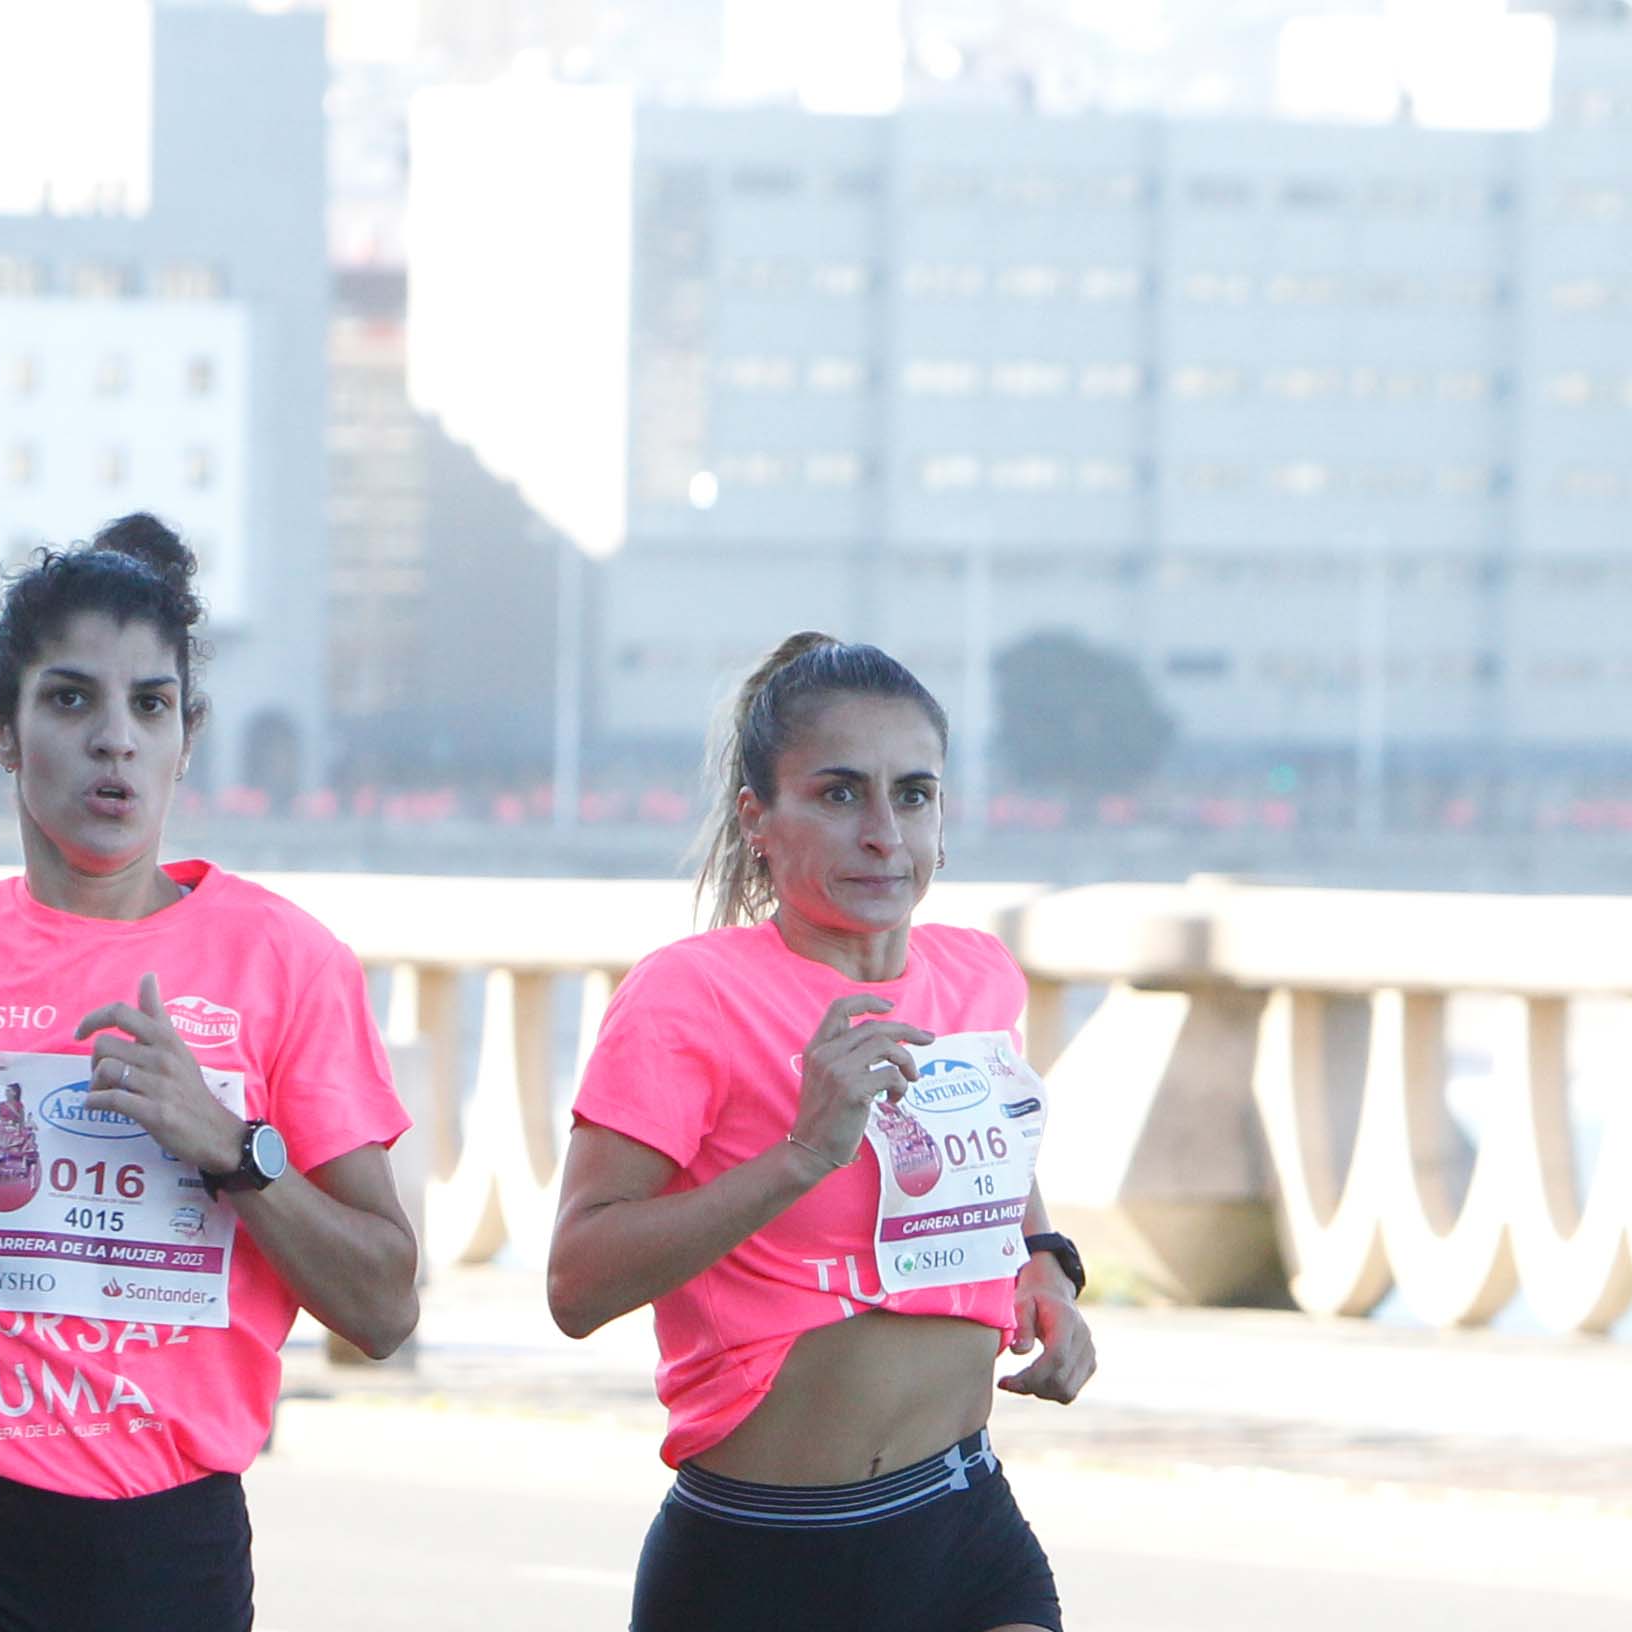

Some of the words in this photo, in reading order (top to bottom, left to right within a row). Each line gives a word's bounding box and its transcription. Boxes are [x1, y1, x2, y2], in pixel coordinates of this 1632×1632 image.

[170, 1014, 237, 1036] STURIANA
[944, 1126, 1007, 1166] 016
[49, 1157, 146, 1199] 016
[974, 1174, 994, 1196] 18
[64, 1206, 125, 1233] 4015
[902, 1215, 960, 1234] CARRERA
[963, 1211, 982, 1225] DE
[984, 1208, 999, 1222] LA
[60, 1242, 83, 1256] DE
[85, 1243, 107, 1259] LA
[109, 1246, 167, 1265] MUJER
[170, 1251, 206, 1267] 2023
[125, 1282, 209, 1304] Santander
